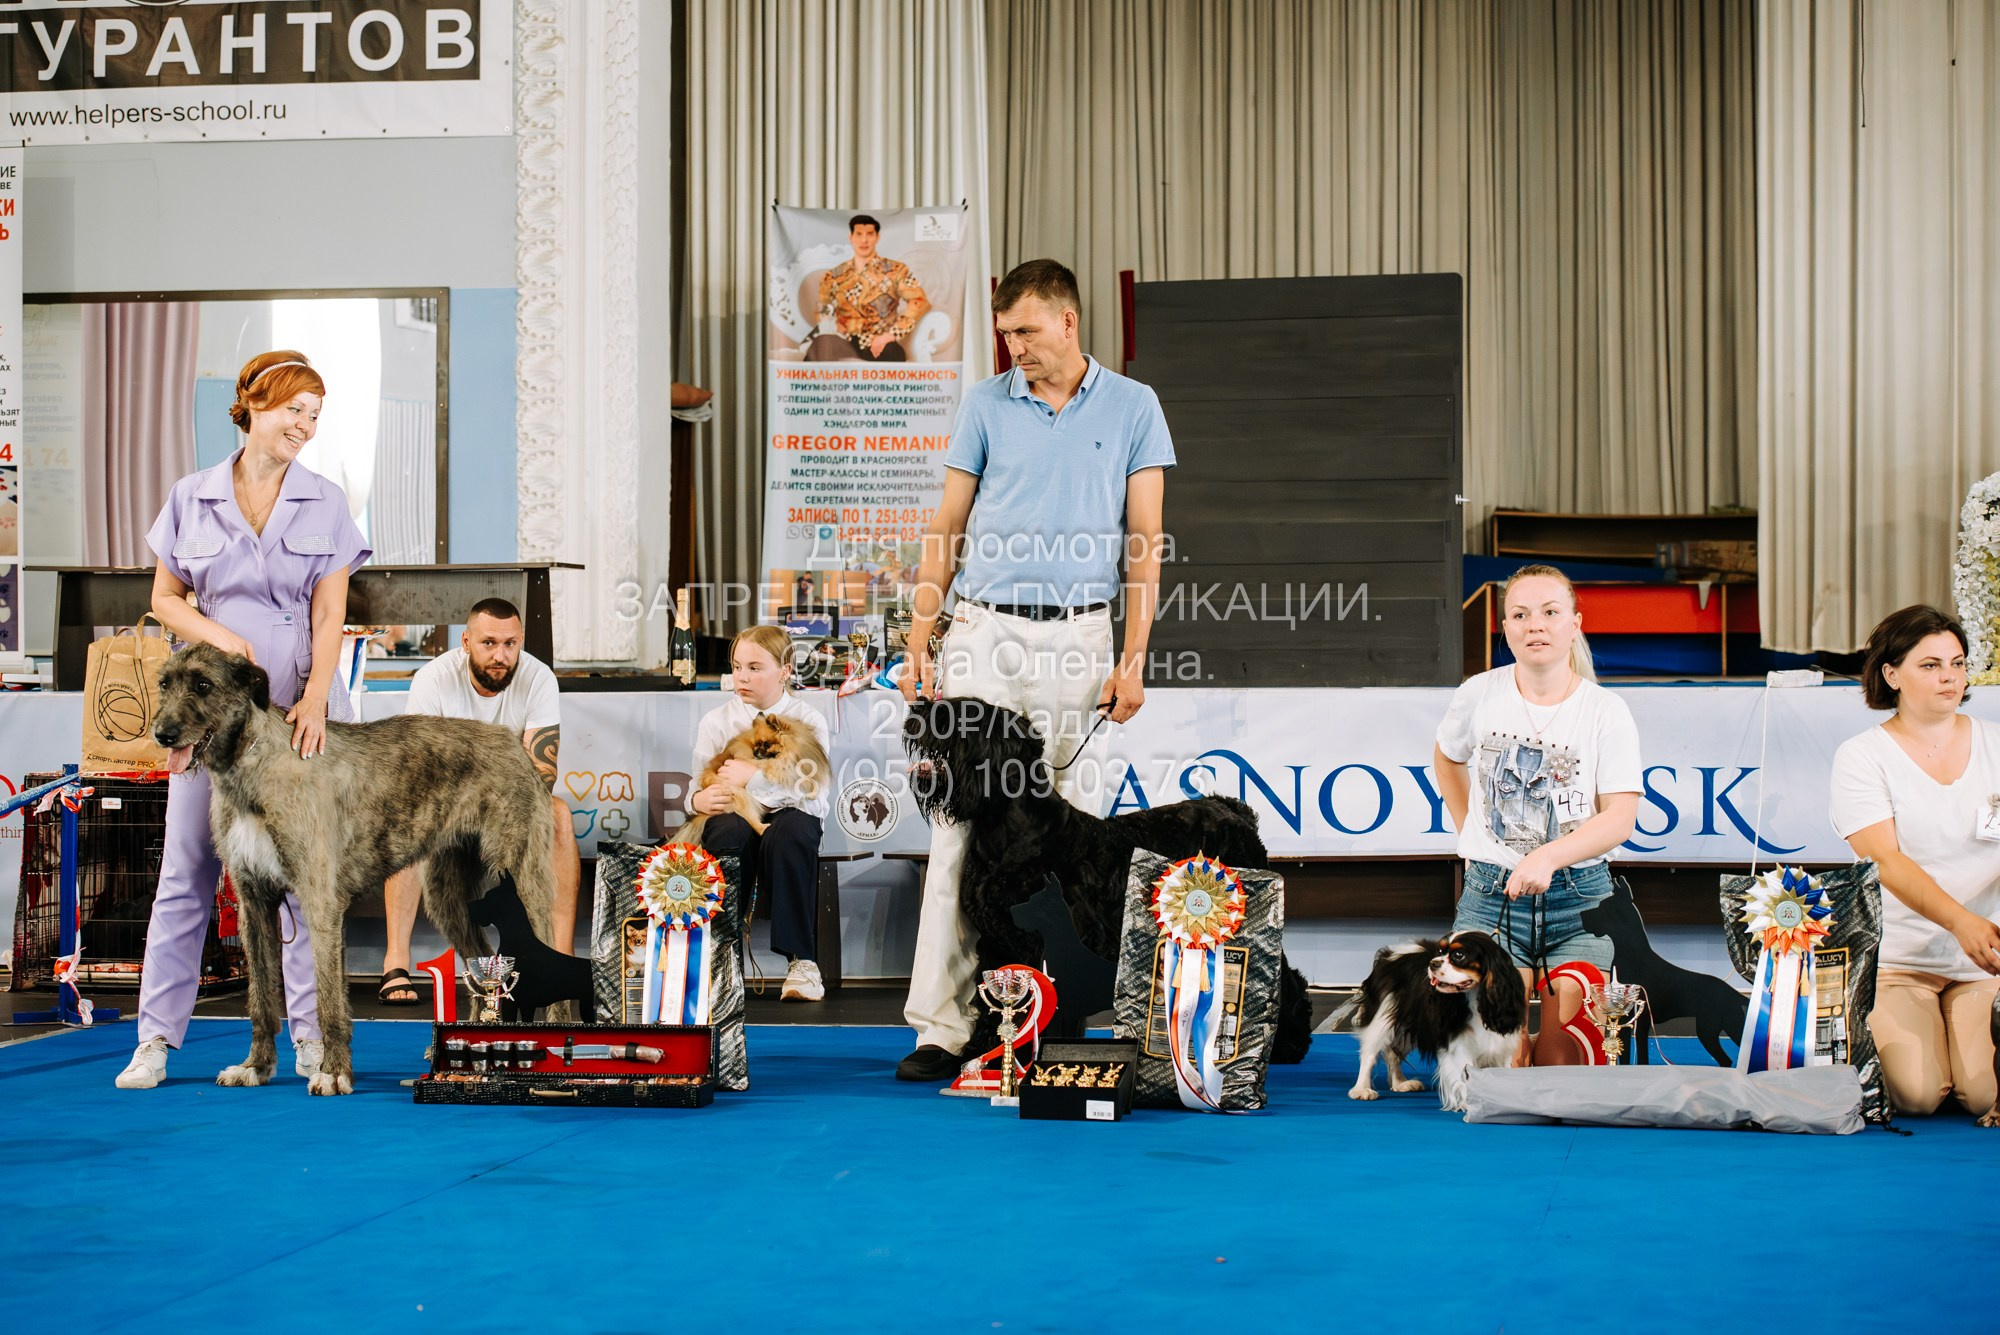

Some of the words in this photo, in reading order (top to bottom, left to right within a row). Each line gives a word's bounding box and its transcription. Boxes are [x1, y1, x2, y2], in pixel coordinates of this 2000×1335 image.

[9, 99, 288, 128] www.helpers-school.ru
[776, 369, 858, 380] УНИКАЛЬНАЯ
[862, 369, 957, 380] ВОЗМОЖНОСТЬ
[790, 383, 850, 392] ТРИУМФАТОР
[853, 383, 901, 392] МИРОВЫХ
[904, 384, 942, 393] РИНГОВ,
[777, 394, 832, 404] УСПЕШНЫЙ
[834, 395, 954, 405] ЗАВОДЧИК-СЕЛЕКЦИОНЕР,
[784, 407, 810, 416] ОДИН
[812, 407, 824, 416] ИЗ
[827, 407, 861, 416] САМЫХ
[864, 407, 947, 416] ХАРИЗМАТИЧНЫХ
[823, 420, 879, 429] ХЭНДЛЕРОВ
[881, 420, 907, 429] МИРА
[772, 435, 857, 450] GREGOR
[800, 455, 849, 465] ПРОВОДИТ
[852, 456, 858, 464] В
[861, 456, 928, 465] КРАСНОЯРСКЕ
[790, 468, 869, 478] МАСТЕР-КЛАССЫ
[871, 469, 878, 478] И
[880, 469, 936, 479] СЕМИНАРЫ,
[771, 481, 812, 491] ДЕЛИТСЯ
[814, 482, 854, 491] СВОИМИ
[805, 495, 859, 505] СЕКРЕТАМИ
[862, 495, 920, 505] МАСТЕРСТВА
[788, 508, 838, 523] ЗАПИСЬ
[842, 508, 859, 523] ПО
[863, 509, 873, 523] Т.
[876, 508, 934, 523] 251-03-17
[137, 760, 155, 769] PRO
[1558, 790, 1588, 816] 47
[416, 948, 457, 1024] 1
